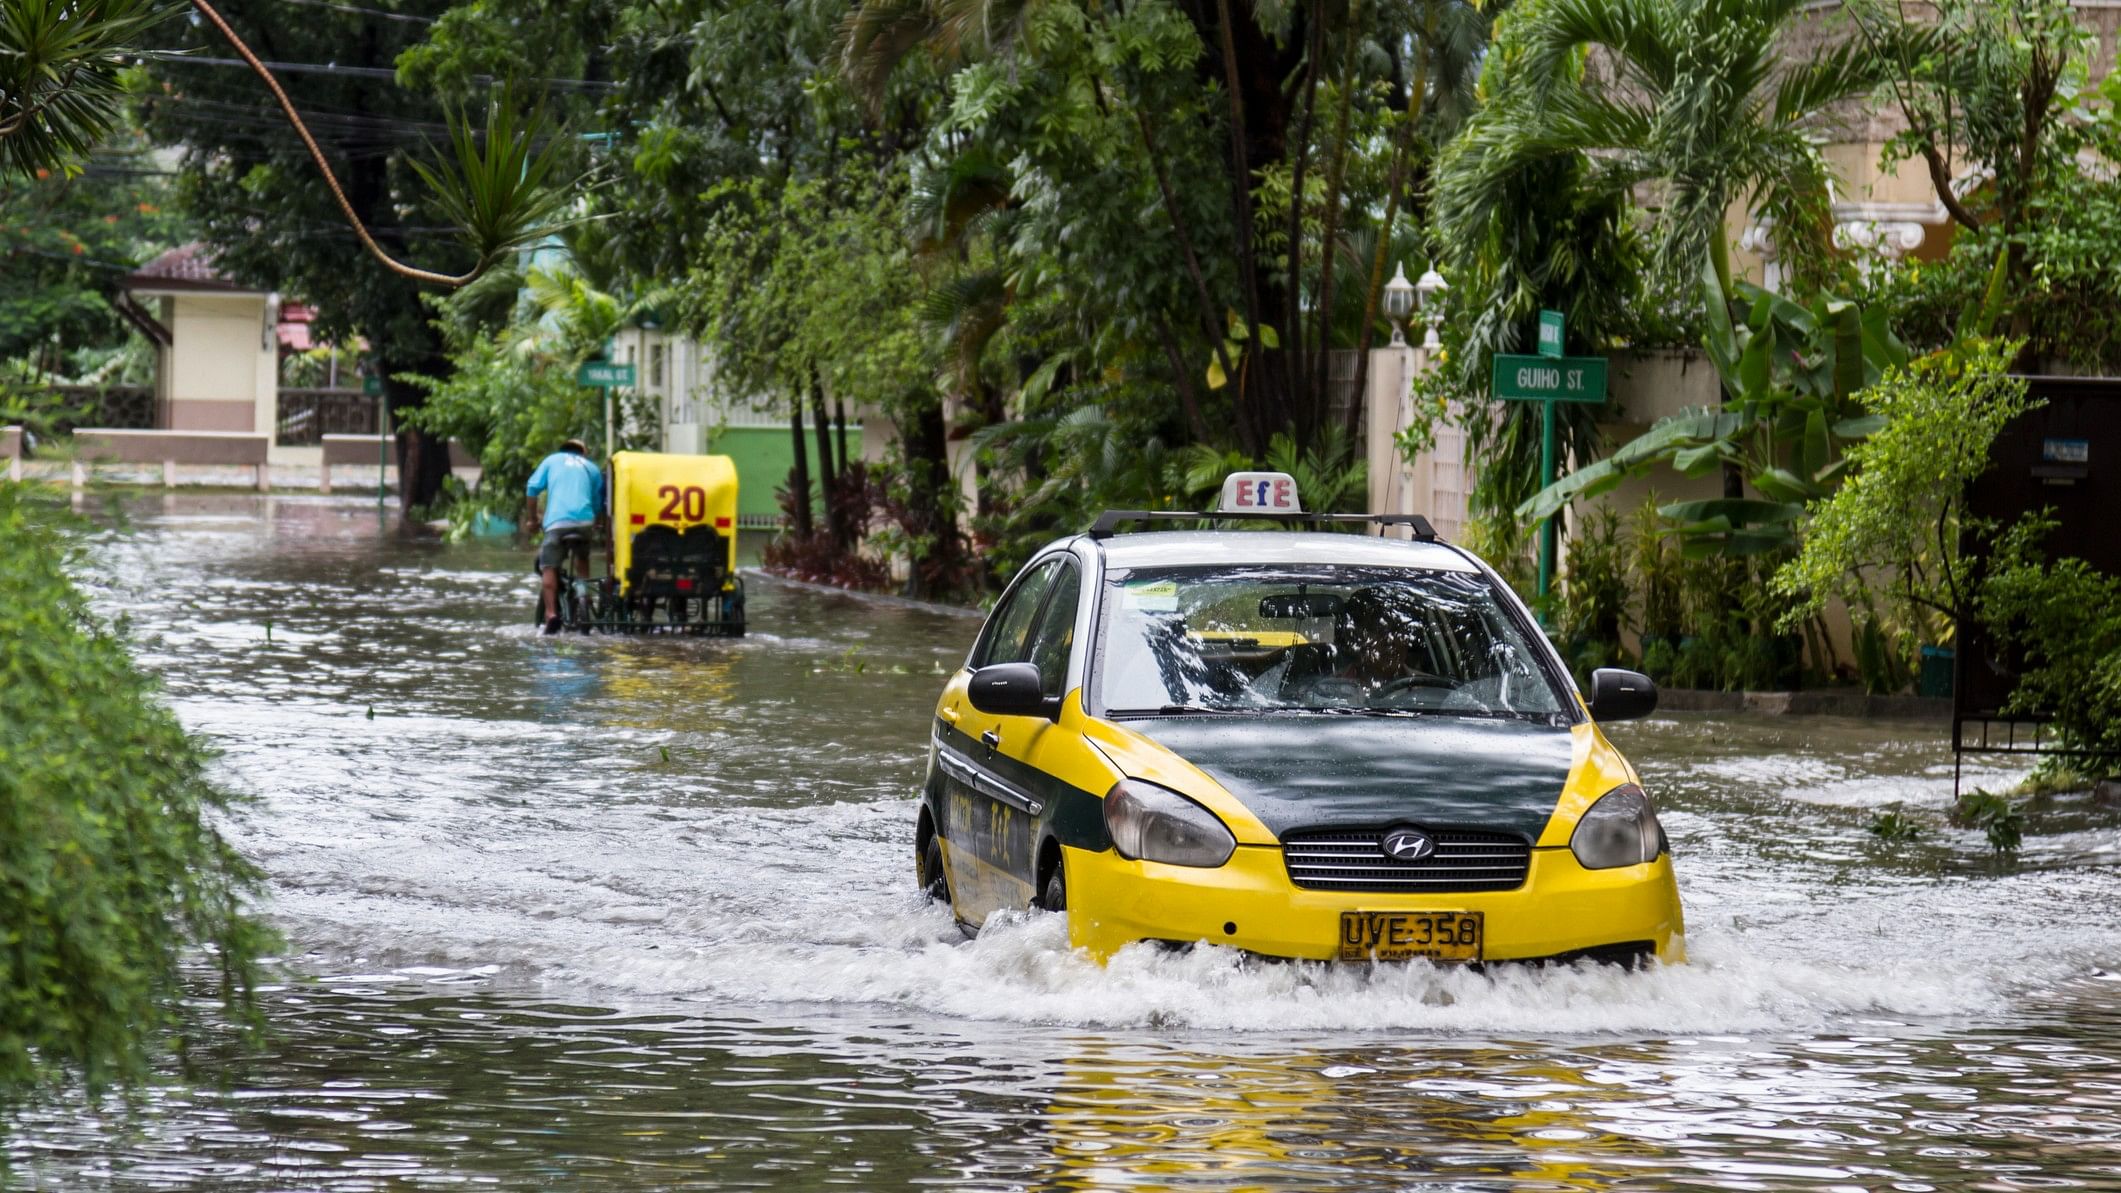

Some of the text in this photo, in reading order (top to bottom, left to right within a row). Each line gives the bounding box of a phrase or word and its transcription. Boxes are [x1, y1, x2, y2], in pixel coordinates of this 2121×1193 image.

[1517, 367, 1585, 390] GUIHO ST.
[658, 485, 706, 522] 20
[1236, 479, 1290, 507] EfE
